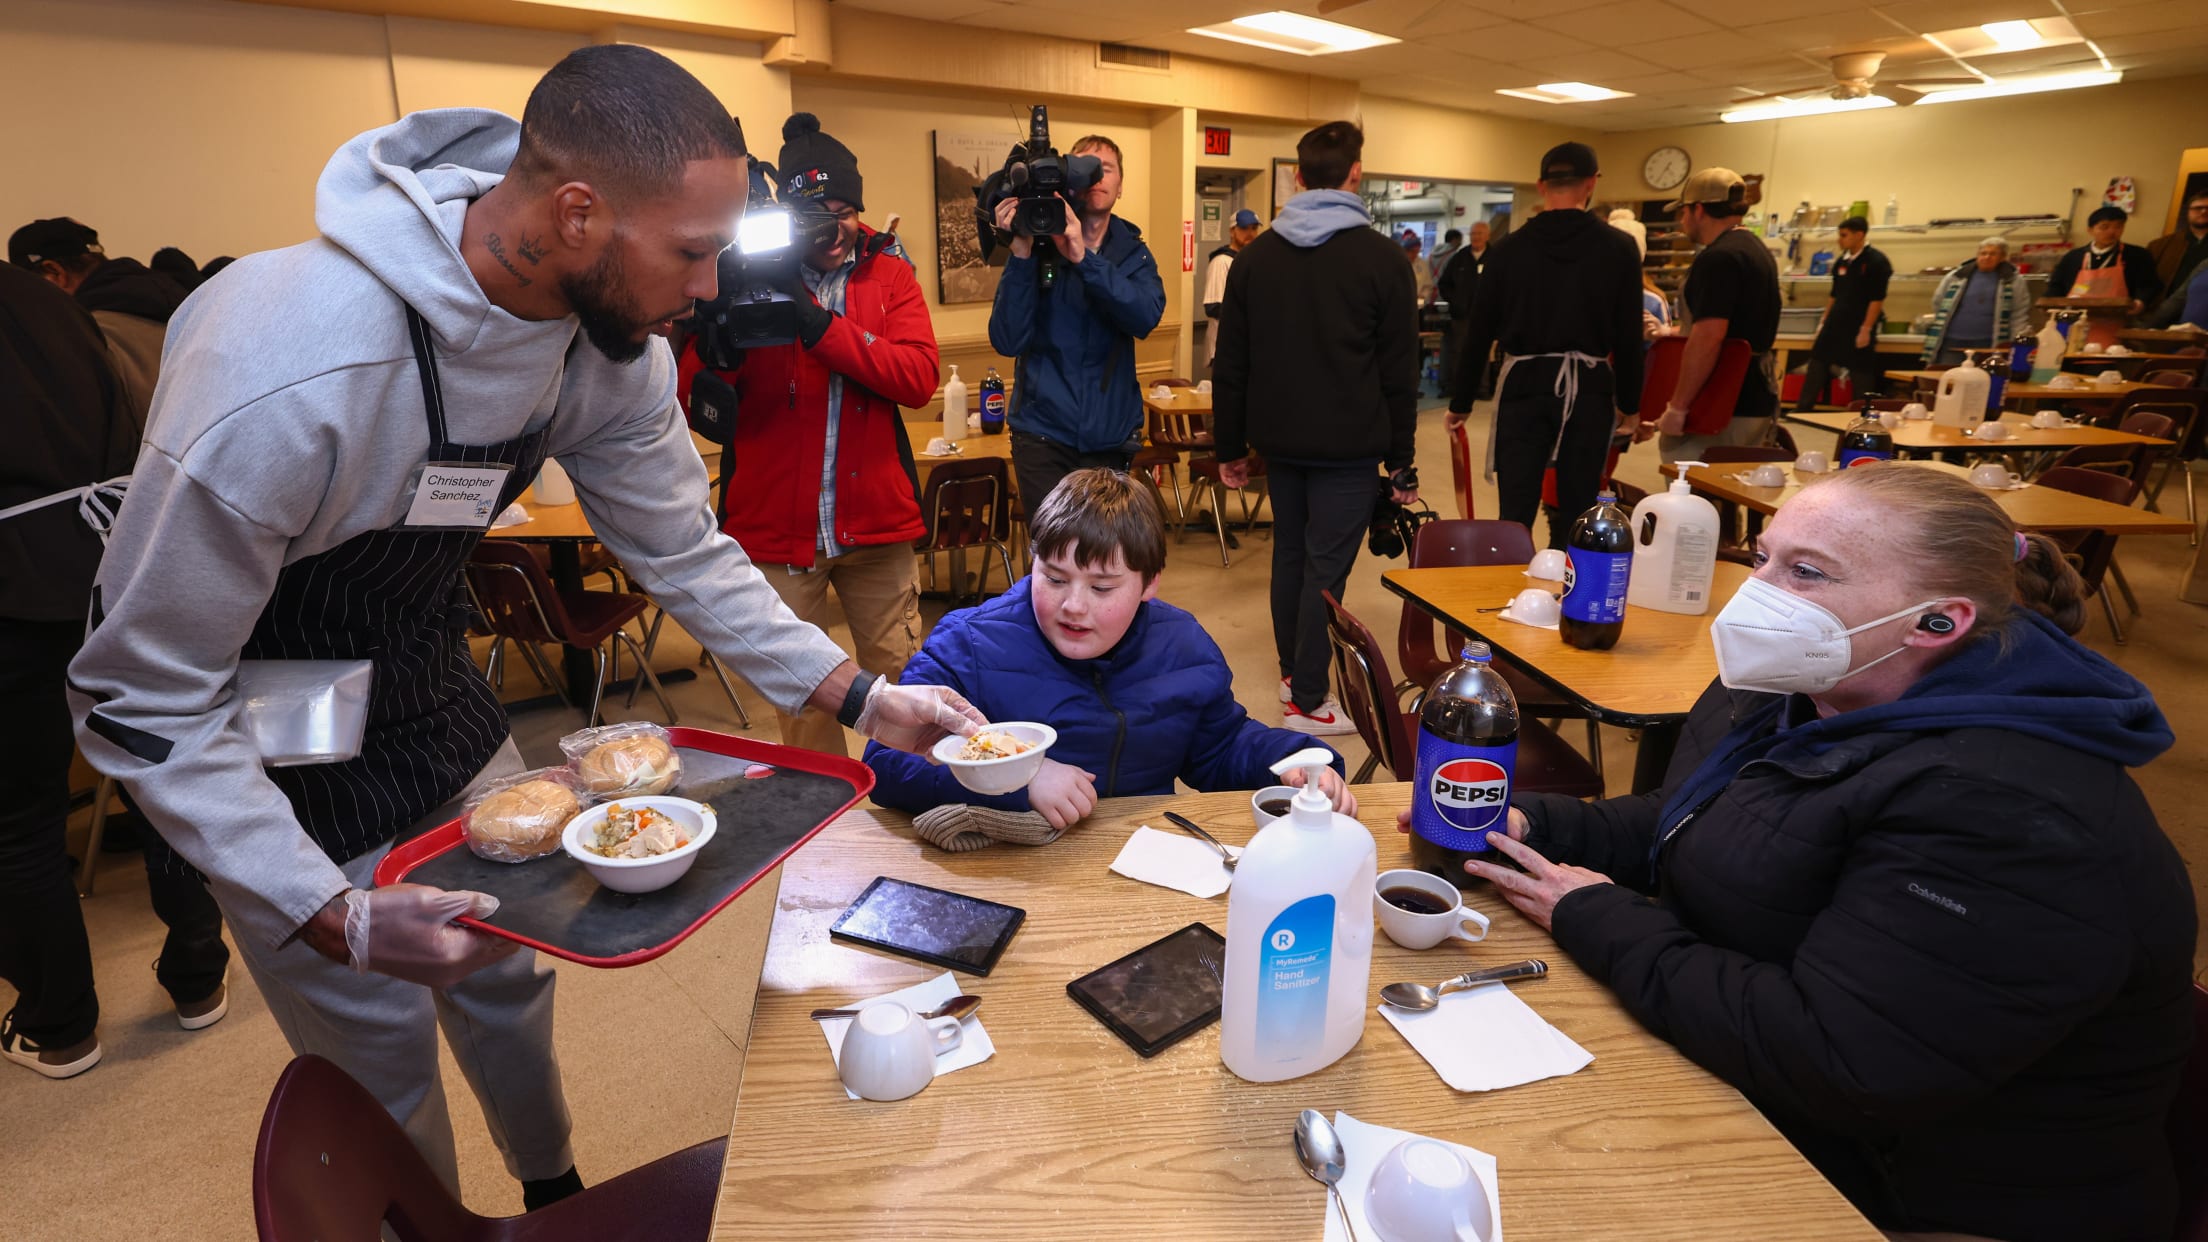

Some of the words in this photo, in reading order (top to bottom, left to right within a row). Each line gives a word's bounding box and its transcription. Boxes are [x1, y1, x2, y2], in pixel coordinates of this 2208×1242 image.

[1206, 129, 1229, 154] EXIT
[427, 474, 495, 489] Christopher
[430, 489, 480, 501] Sanchez
[1805, 651, 1830, 659] KN95
[1435, 779, 1506, 803] PEPSI
[1908, 882, 1942, 904] Calvin
[1278, 933, 1290, 947] R
[1275, 969, 1305, 981] Hand
[1274, 976, 1321, 990] Sanitizer
